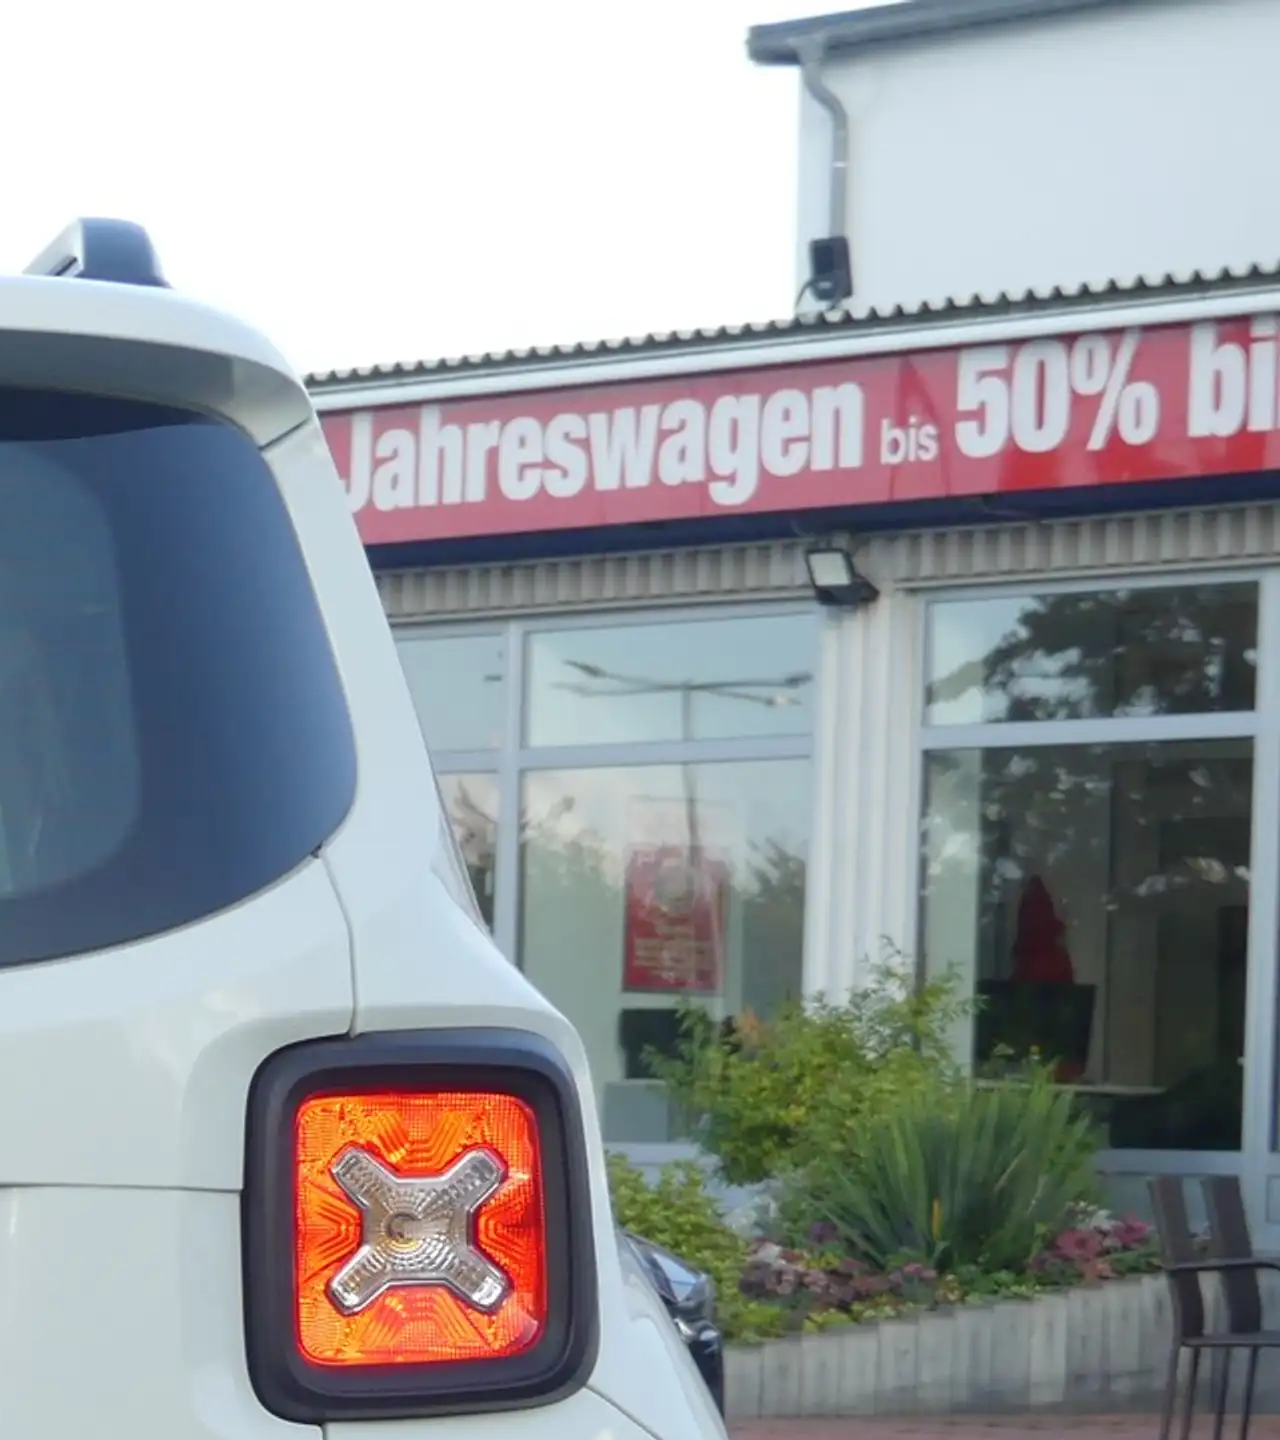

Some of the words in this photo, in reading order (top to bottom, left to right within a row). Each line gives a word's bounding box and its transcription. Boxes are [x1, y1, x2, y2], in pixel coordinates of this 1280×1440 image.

[338, 381, 864, 514] Jahreswagen
[880, 416, 939, 465] bis
[954, 326, 1160, 459] 50%
[1187, 316, 1280, 437] bi
